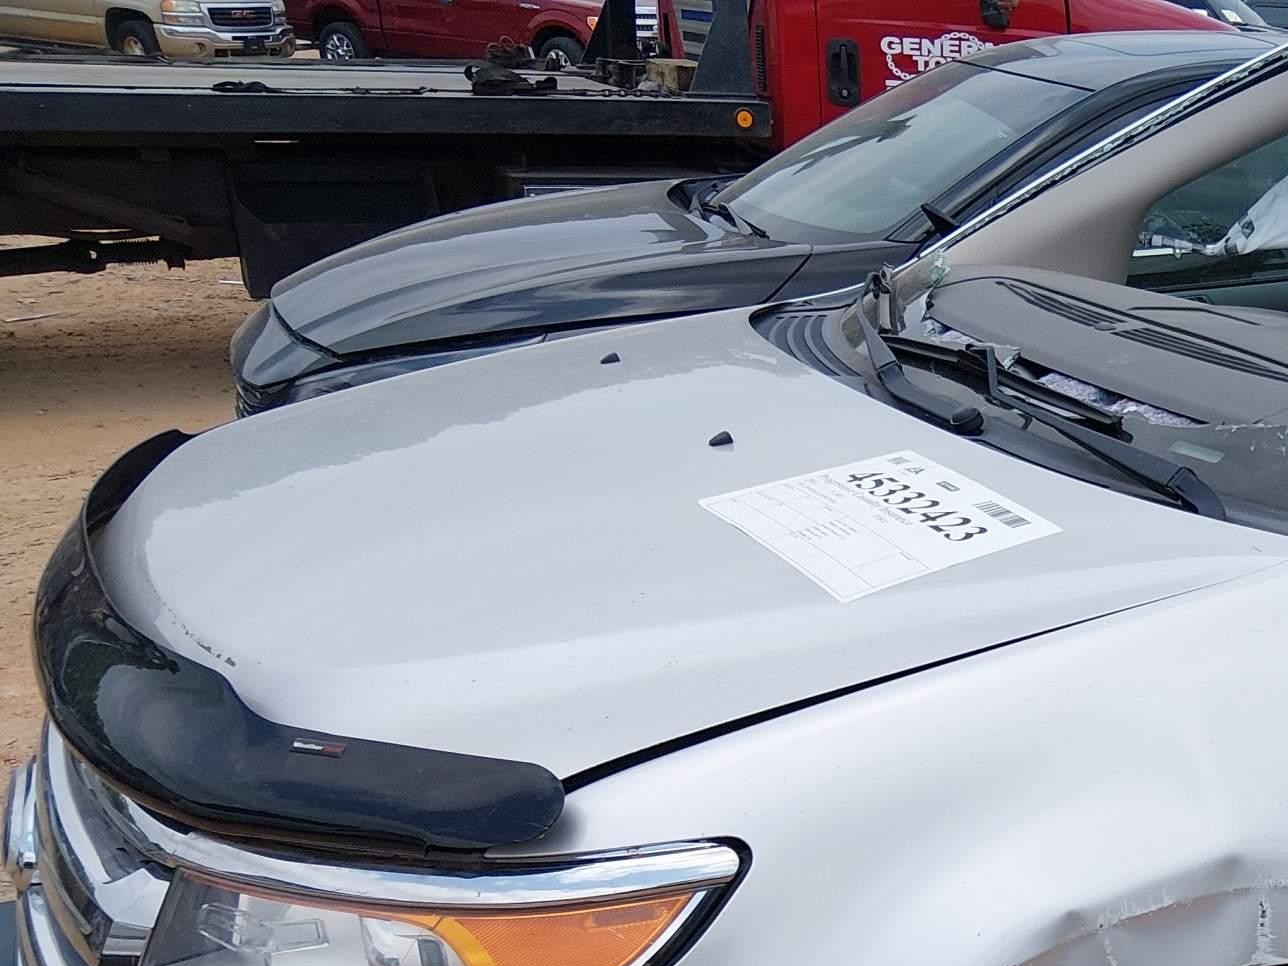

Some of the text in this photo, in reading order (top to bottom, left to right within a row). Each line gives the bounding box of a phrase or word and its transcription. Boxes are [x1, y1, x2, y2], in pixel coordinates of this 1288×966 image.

[880, 36, 1000, 59] GENER
[912, 54, 953, 73] TO
[846, 472, 989, 542] 45332423
